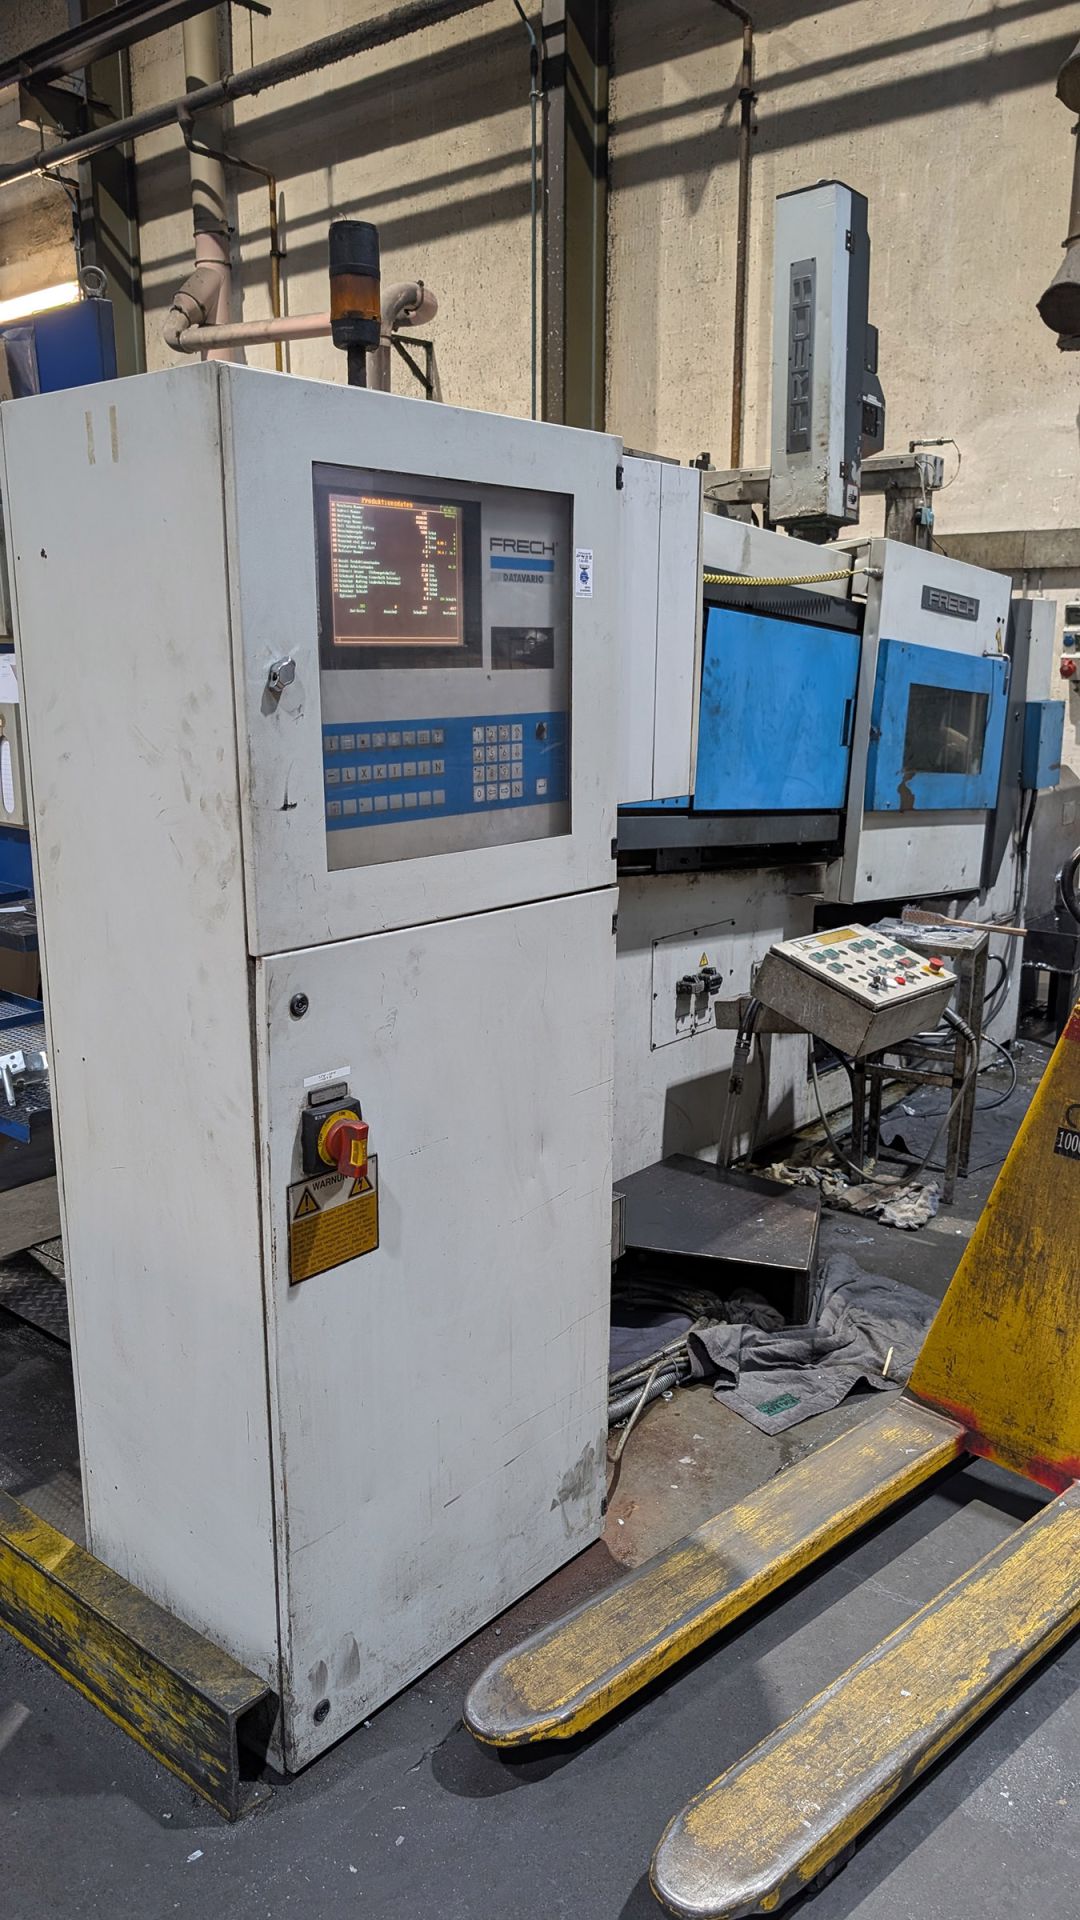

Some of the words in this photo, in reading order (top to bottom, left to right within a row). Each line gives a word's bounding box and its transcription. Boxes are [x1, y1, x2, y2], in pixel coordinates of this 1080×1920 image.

[791, 275, 813, 433] FRECH
[489, 537, 555, 556] FRECH
[503, 573, 544, 584] DATAVARIO
[929, 590, 976, 616] FRECH
[1057, 1131, 1080, 1155] 100
[312, 1173, 349, 1191] WARNUN
